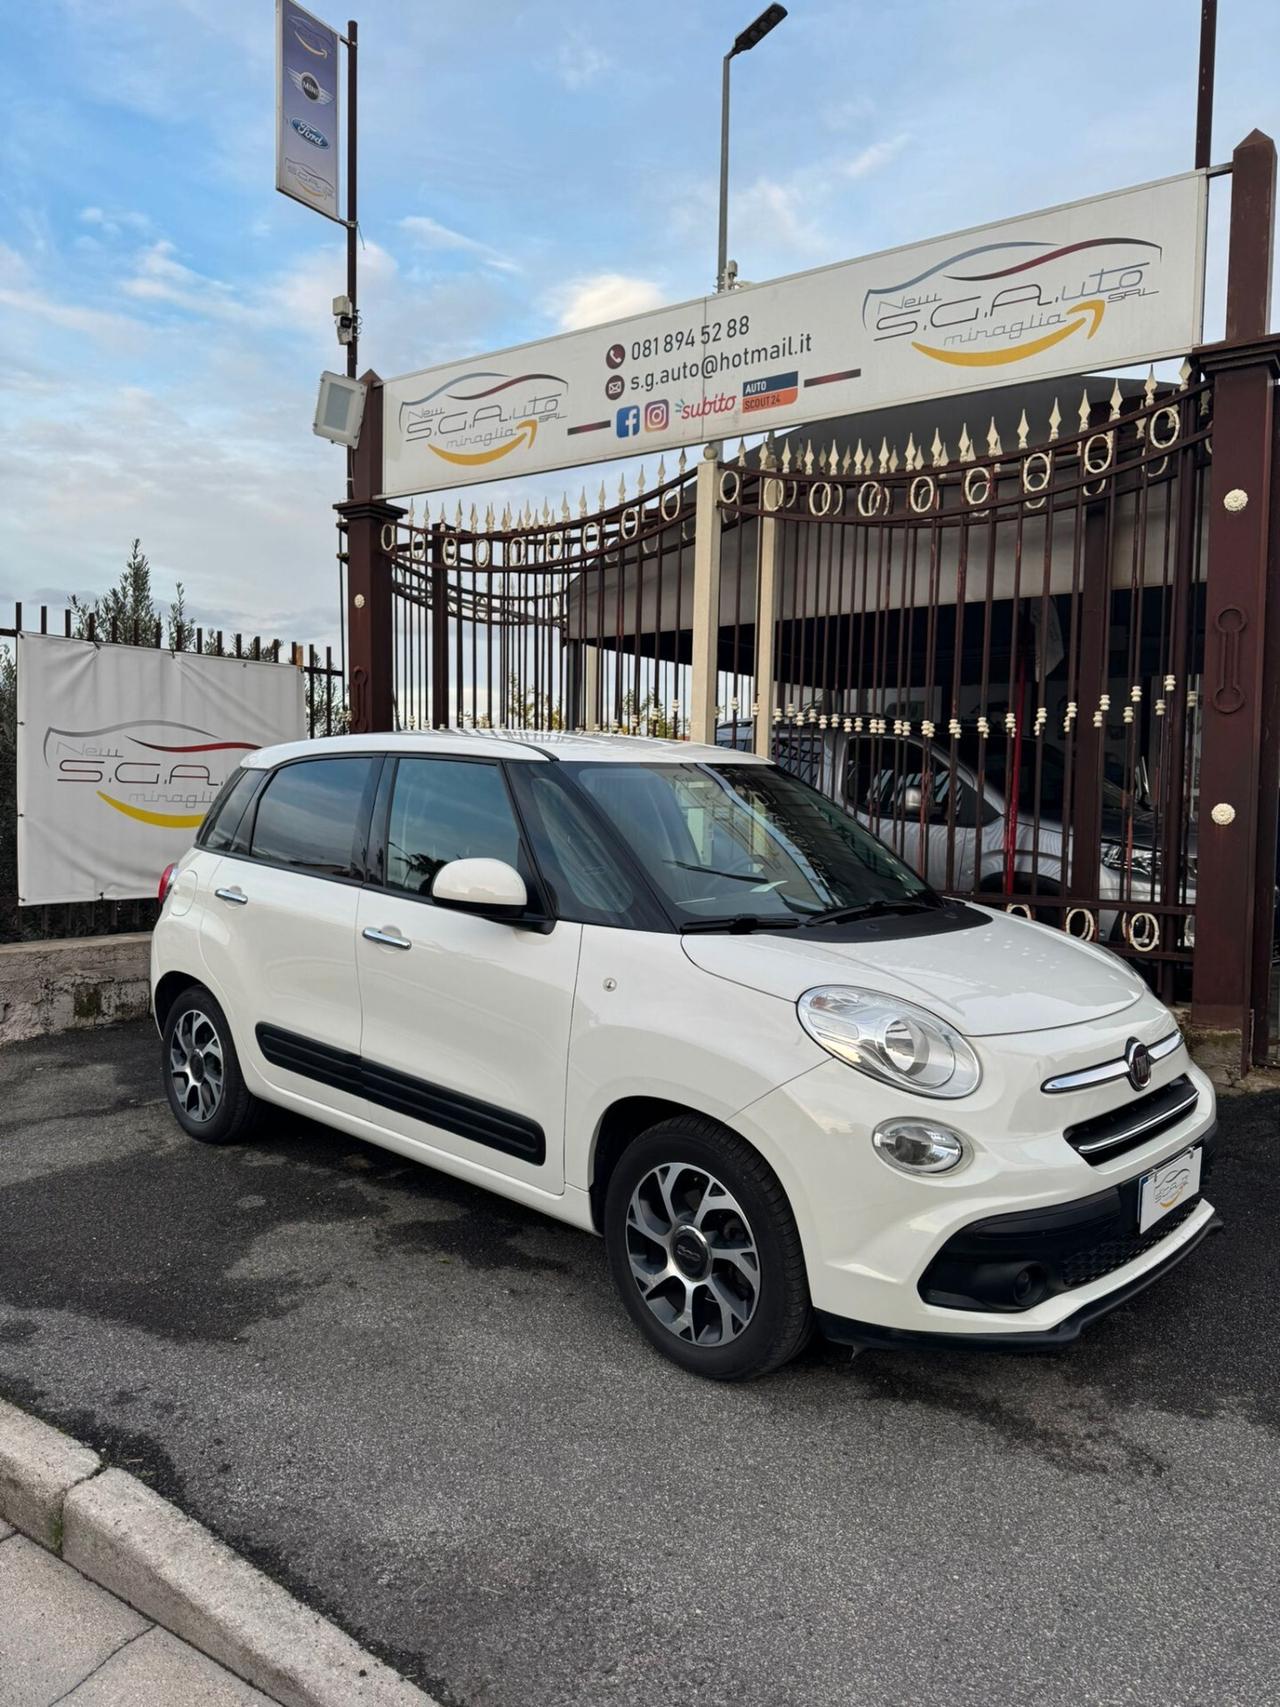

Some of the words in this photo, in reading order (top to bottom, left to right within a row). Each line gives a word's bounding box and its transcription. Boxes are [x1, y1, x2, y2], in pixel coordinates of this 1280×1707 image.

[298, 122, 323, 145] Ford
[878, 293, 942, 315] New
[1107, 288, 1160, 304] SRL
[632, 336, 658, 360] 081
[664, 329, 695, 353] 894
[701, 322, 722, 345] 52
[727, 315, 749, 338] 88
[944, 311, 1067, 346] miraglia
[631, 333, 812, 392] s.g.auto@hotmail.it
[745, 381, 767, 395] AUTO
[681, 392, 737, 420] subito
[744, 396, 770, 411] SCOUT
[771, 394, 781, 405] 24
[408, 407, 445, 421] New
[446, 427, 517, 449] miraglia
[56, 741, 124, 758] New
[57, 759, 226, 786] S.G.A.
[129, 790, 214, 809] miragli
